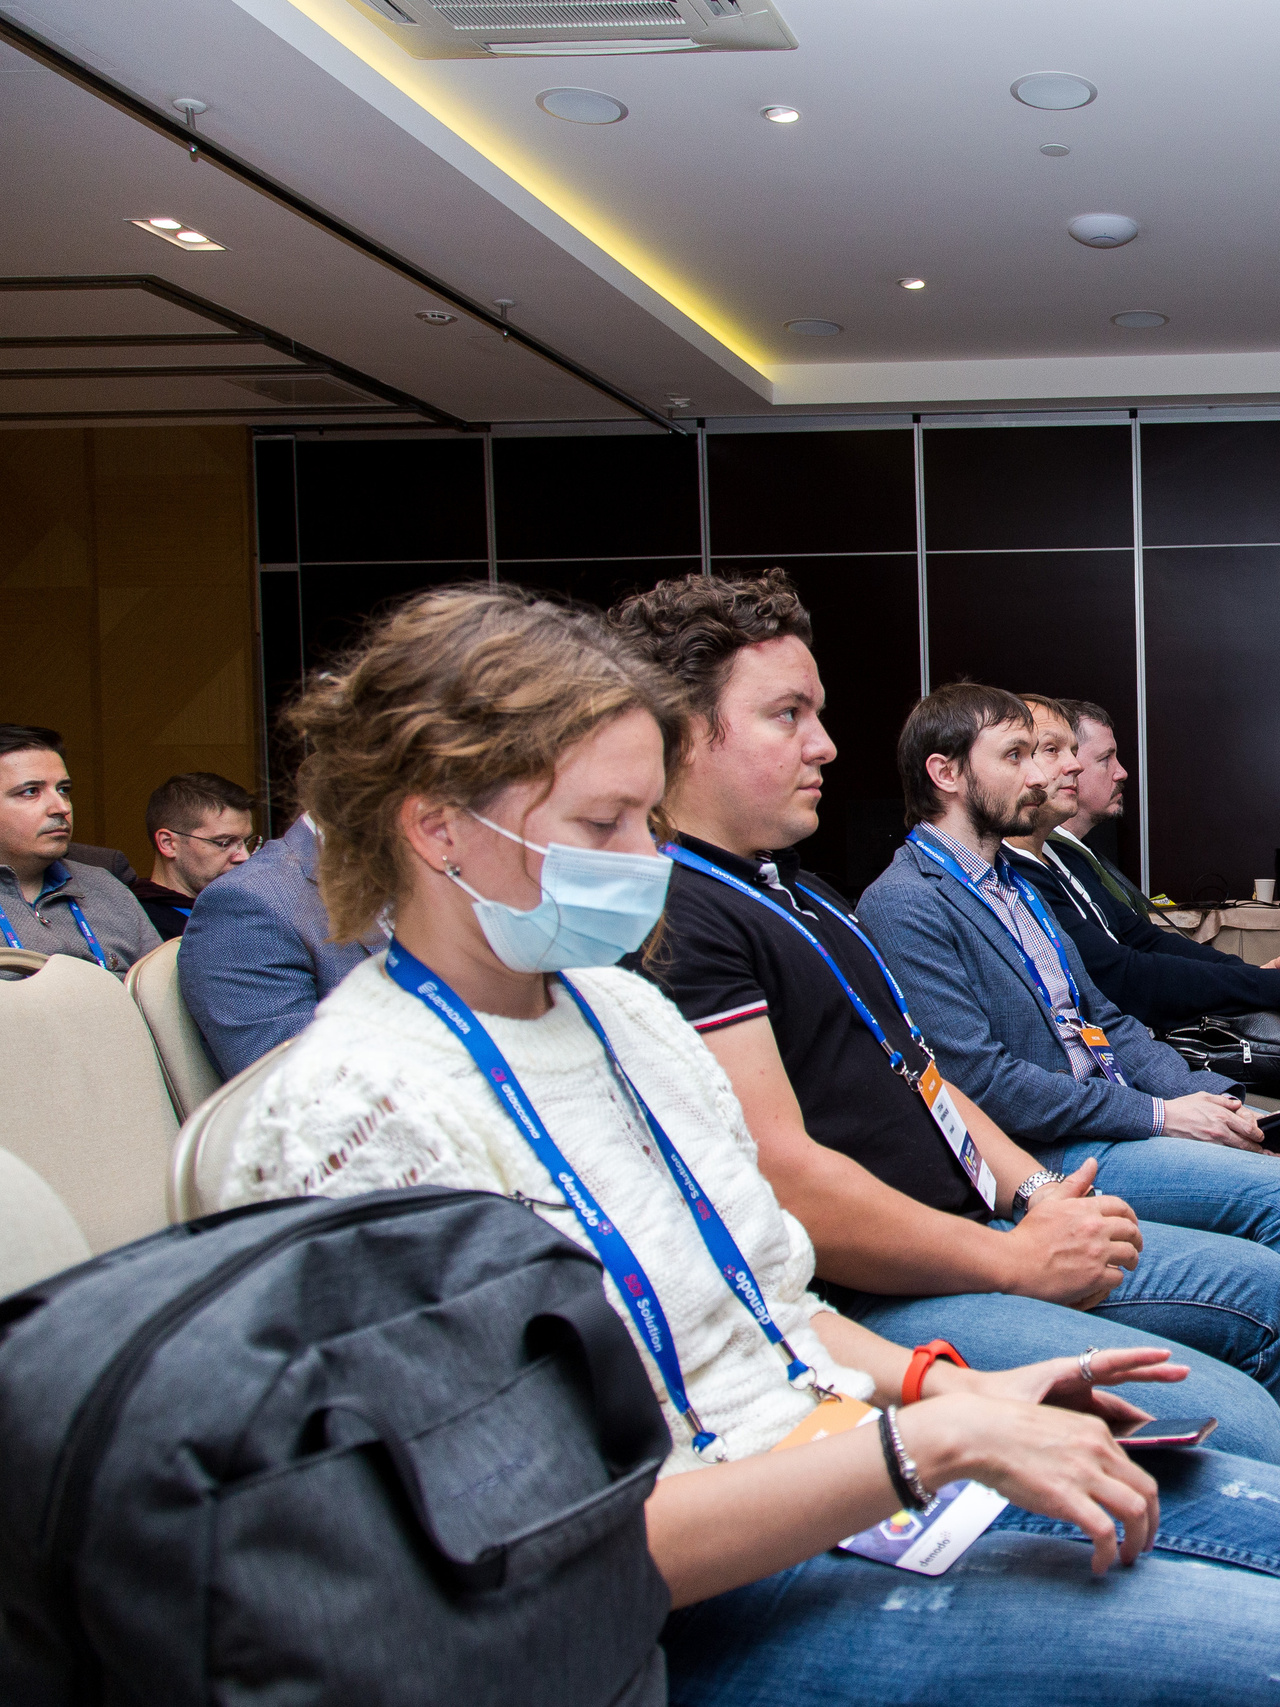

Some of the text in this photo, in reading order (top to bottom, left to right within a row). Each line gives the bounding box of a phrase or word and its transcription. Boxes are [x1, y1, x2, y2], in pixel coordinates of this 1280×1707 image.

[426, 991, 472, 1036] ARENADATA
[501, 1083, 541, 1139] ataccama
[558, 1171, 599, 1227] denodo
[670, 1153, 700, 1200] Solution
[637, 1298, 664, 1353] Solution
[735, 1270, 772, 1326] denodo
